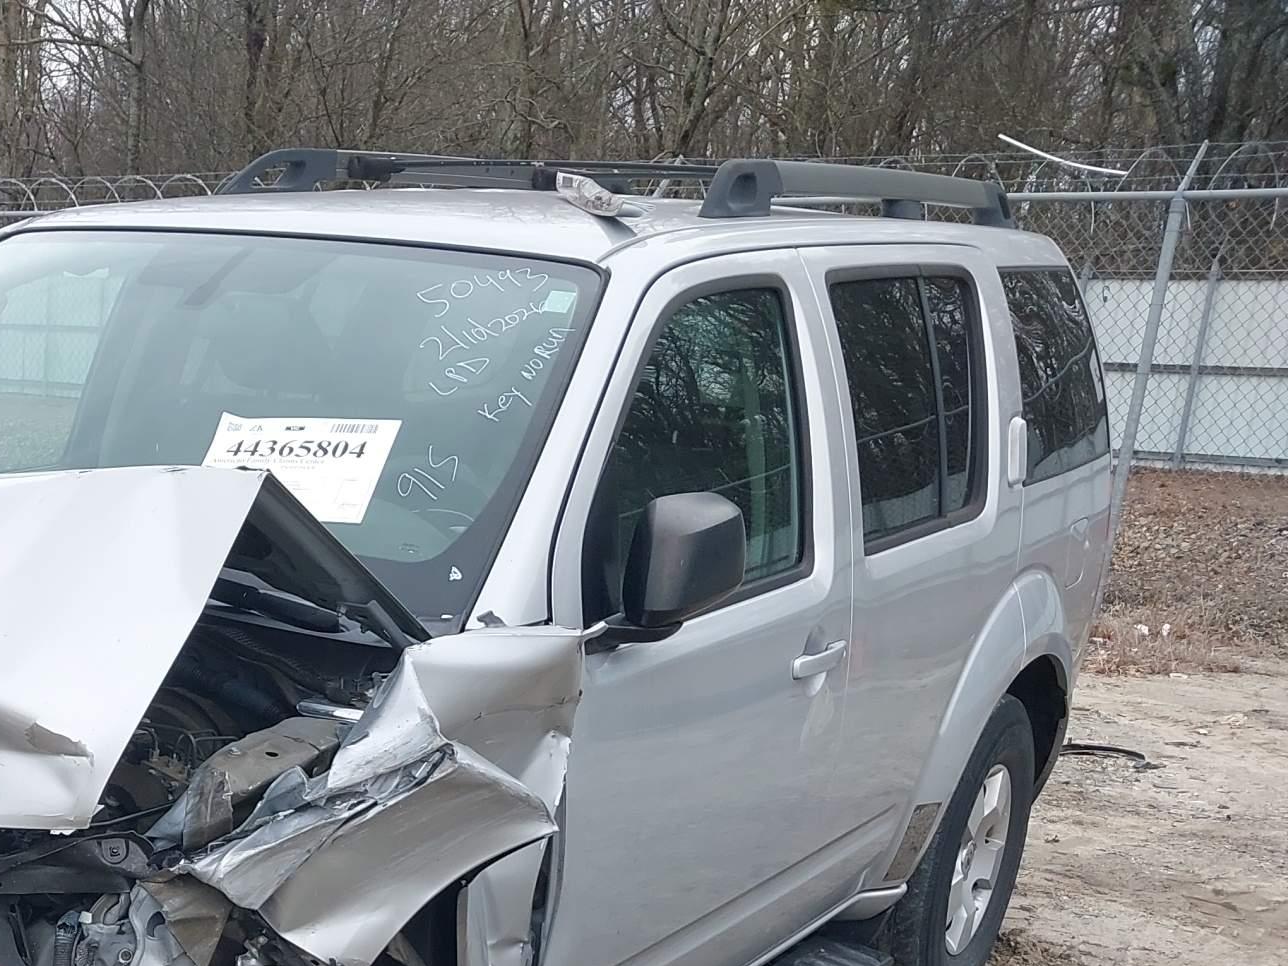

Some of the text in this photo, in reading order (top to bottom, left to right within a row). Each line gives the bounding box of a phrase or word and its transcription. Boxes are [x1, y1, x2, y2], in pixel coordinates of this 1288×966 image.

[416, 267, 549, 318] 50493
[225, 439, 368, 459] 44365804
[397, 445, 459, 500] 915
